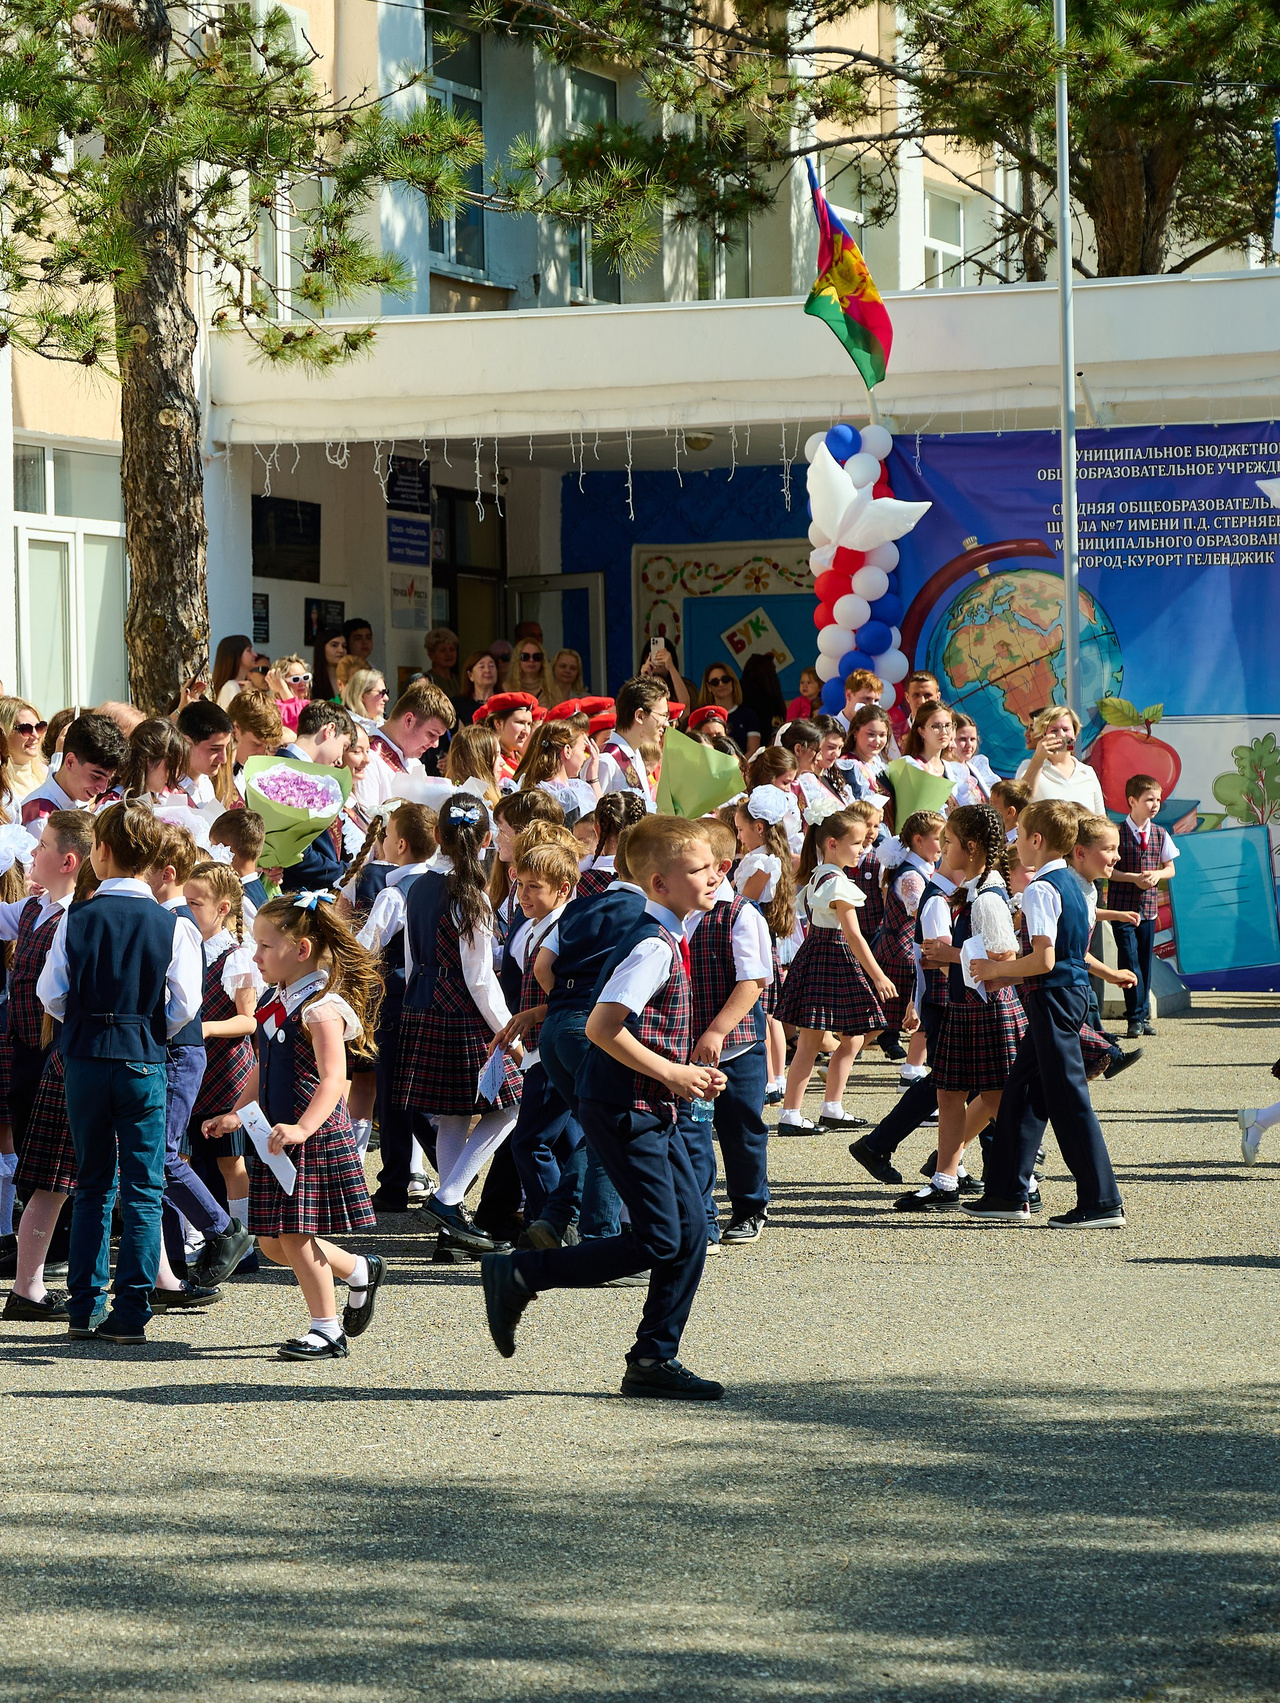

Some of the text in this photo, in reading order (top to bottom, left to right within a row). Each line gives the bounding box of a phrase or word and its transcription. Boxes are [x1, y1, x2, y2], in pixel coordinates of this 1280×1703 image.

[1076, 442, 1280, 462] УНИЦИПАЛЬНОЕ БЮДЖЕТНО
[1037, 463, 1215, 481] ОБОБРАЗОВАТЕЛЬНОЕ
[1052, 502, 1115, 516] СДНЯЯ
[1046, 520, 1097, 533] ШЛА
[1101, 519, 1124, 532] №7
[1128, 518, 1179, 531] ИМЕНИ
[1183, 517, 1210, 531] П.Д.
[1055, 533, 1280, 551] МНИЦИПАЛЬНОГО ОБРАЗОВАН
[1078, 551, 1275, 569] ГОРОД-КУРОРТ ГЕЛЕНДЖИК
